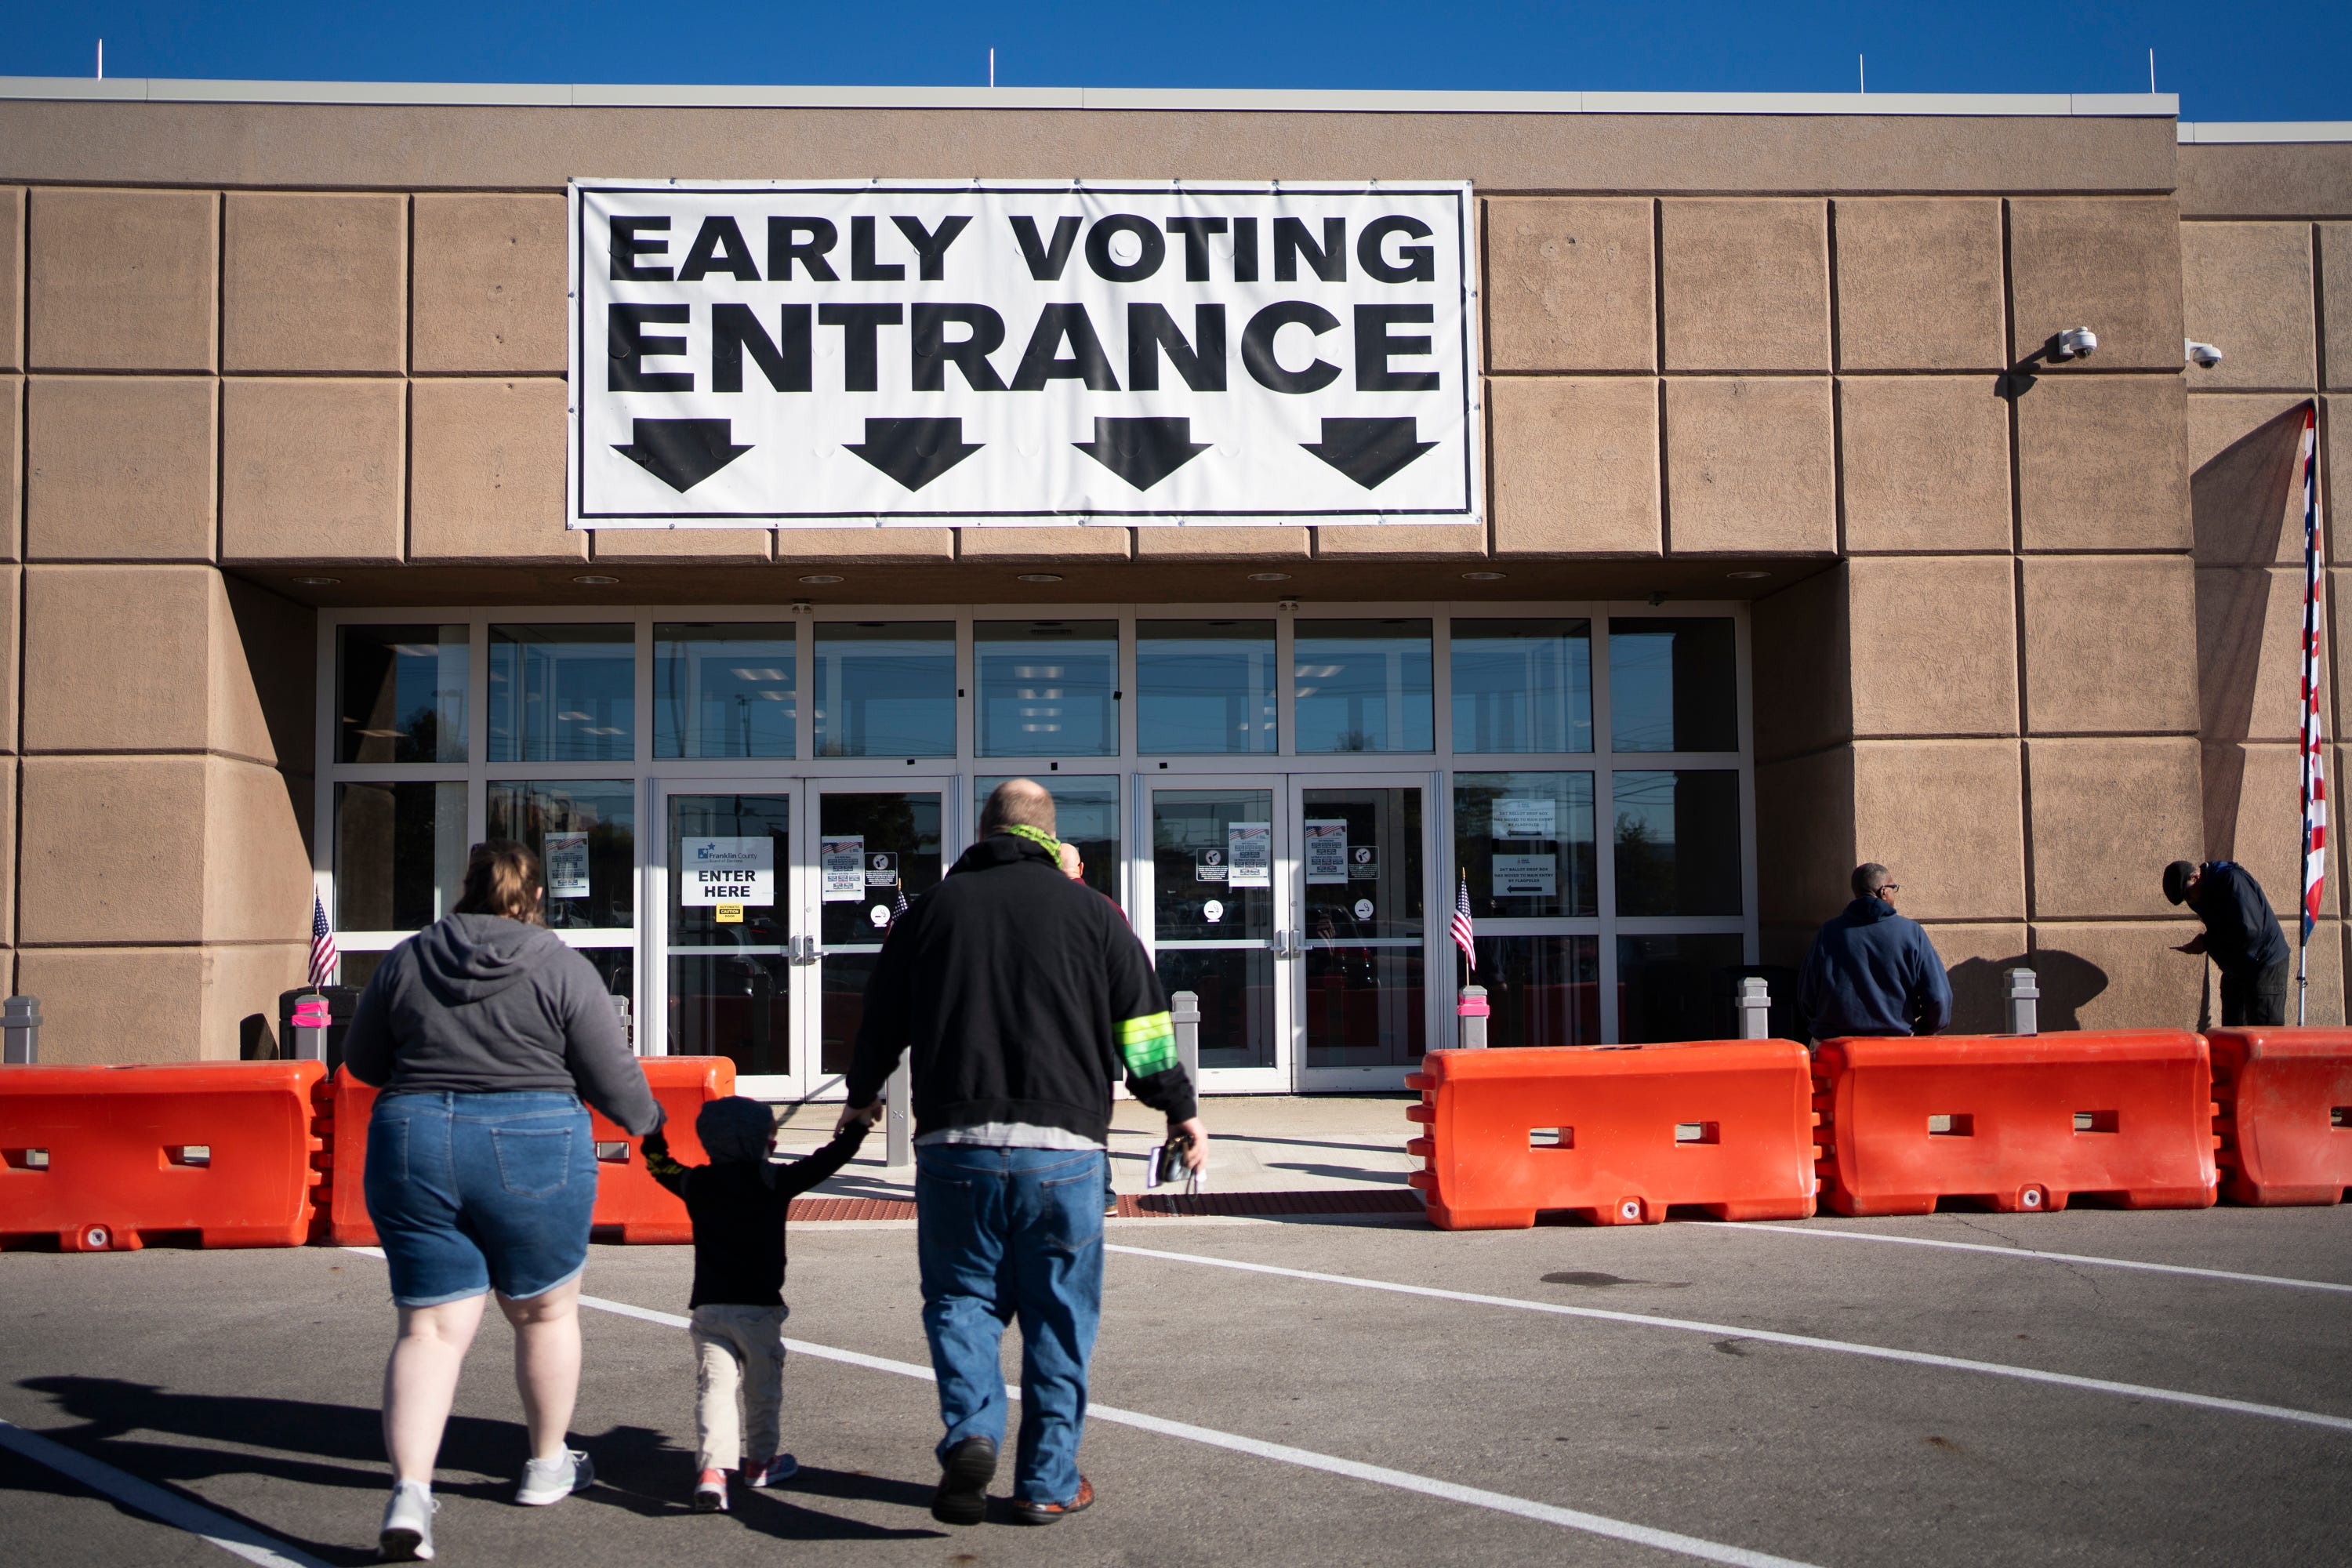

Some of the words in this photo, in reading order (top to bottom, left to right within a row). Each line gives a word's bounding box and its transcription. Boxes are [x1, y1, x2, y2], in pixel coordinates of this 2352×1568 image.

[610, 216, 971, 281] EARLY
[1009, 215, 1434, 283] VOTING
[608, 301, 1439, 394] ENTRANCE
[699, 870, 756, 882] ENTER
[704, 886, 750, 898] HERE
